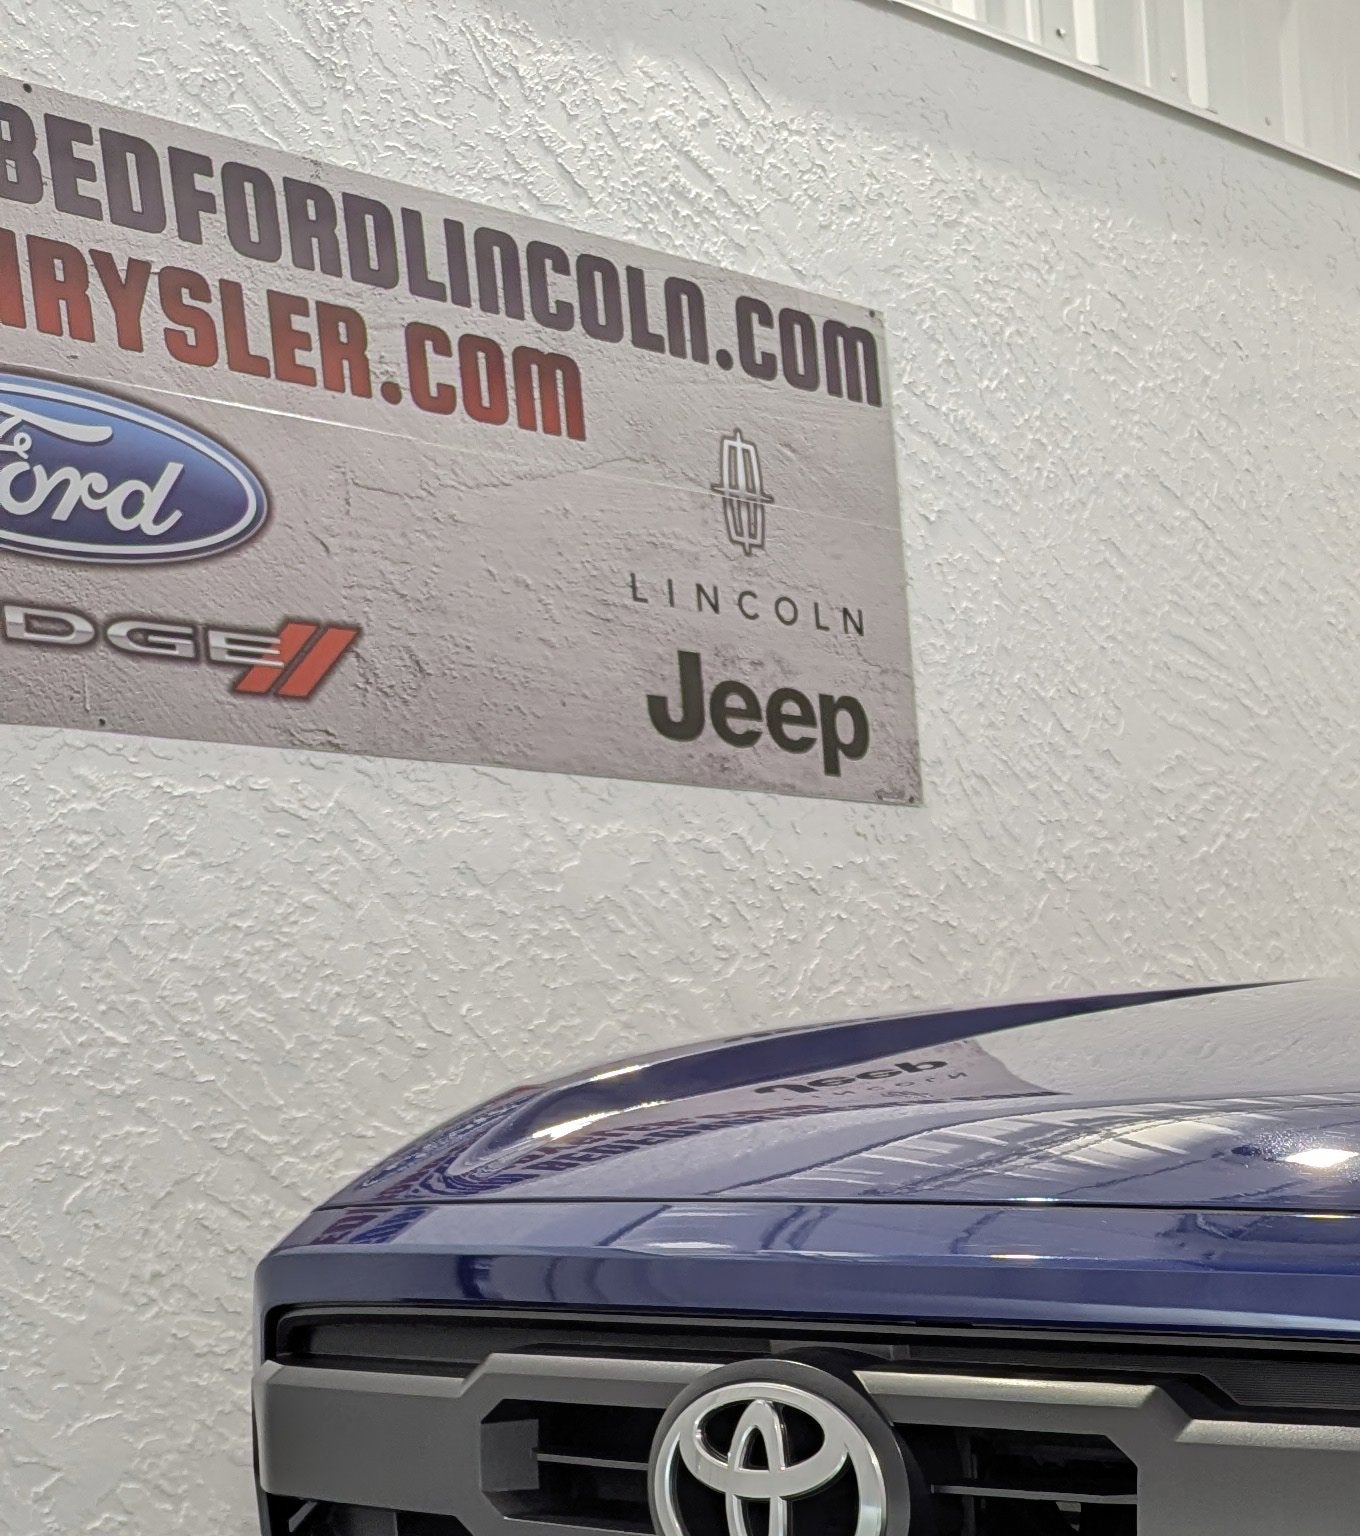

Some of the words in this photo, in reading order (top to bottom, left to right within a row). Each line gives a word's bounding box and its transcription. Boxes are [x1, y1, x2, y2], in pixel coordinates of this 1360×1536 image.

[4, 604, 285, 670] DGE
[630, 572, 864, 637] LINCOLN
[646, 649, 870, 778] Jeep
